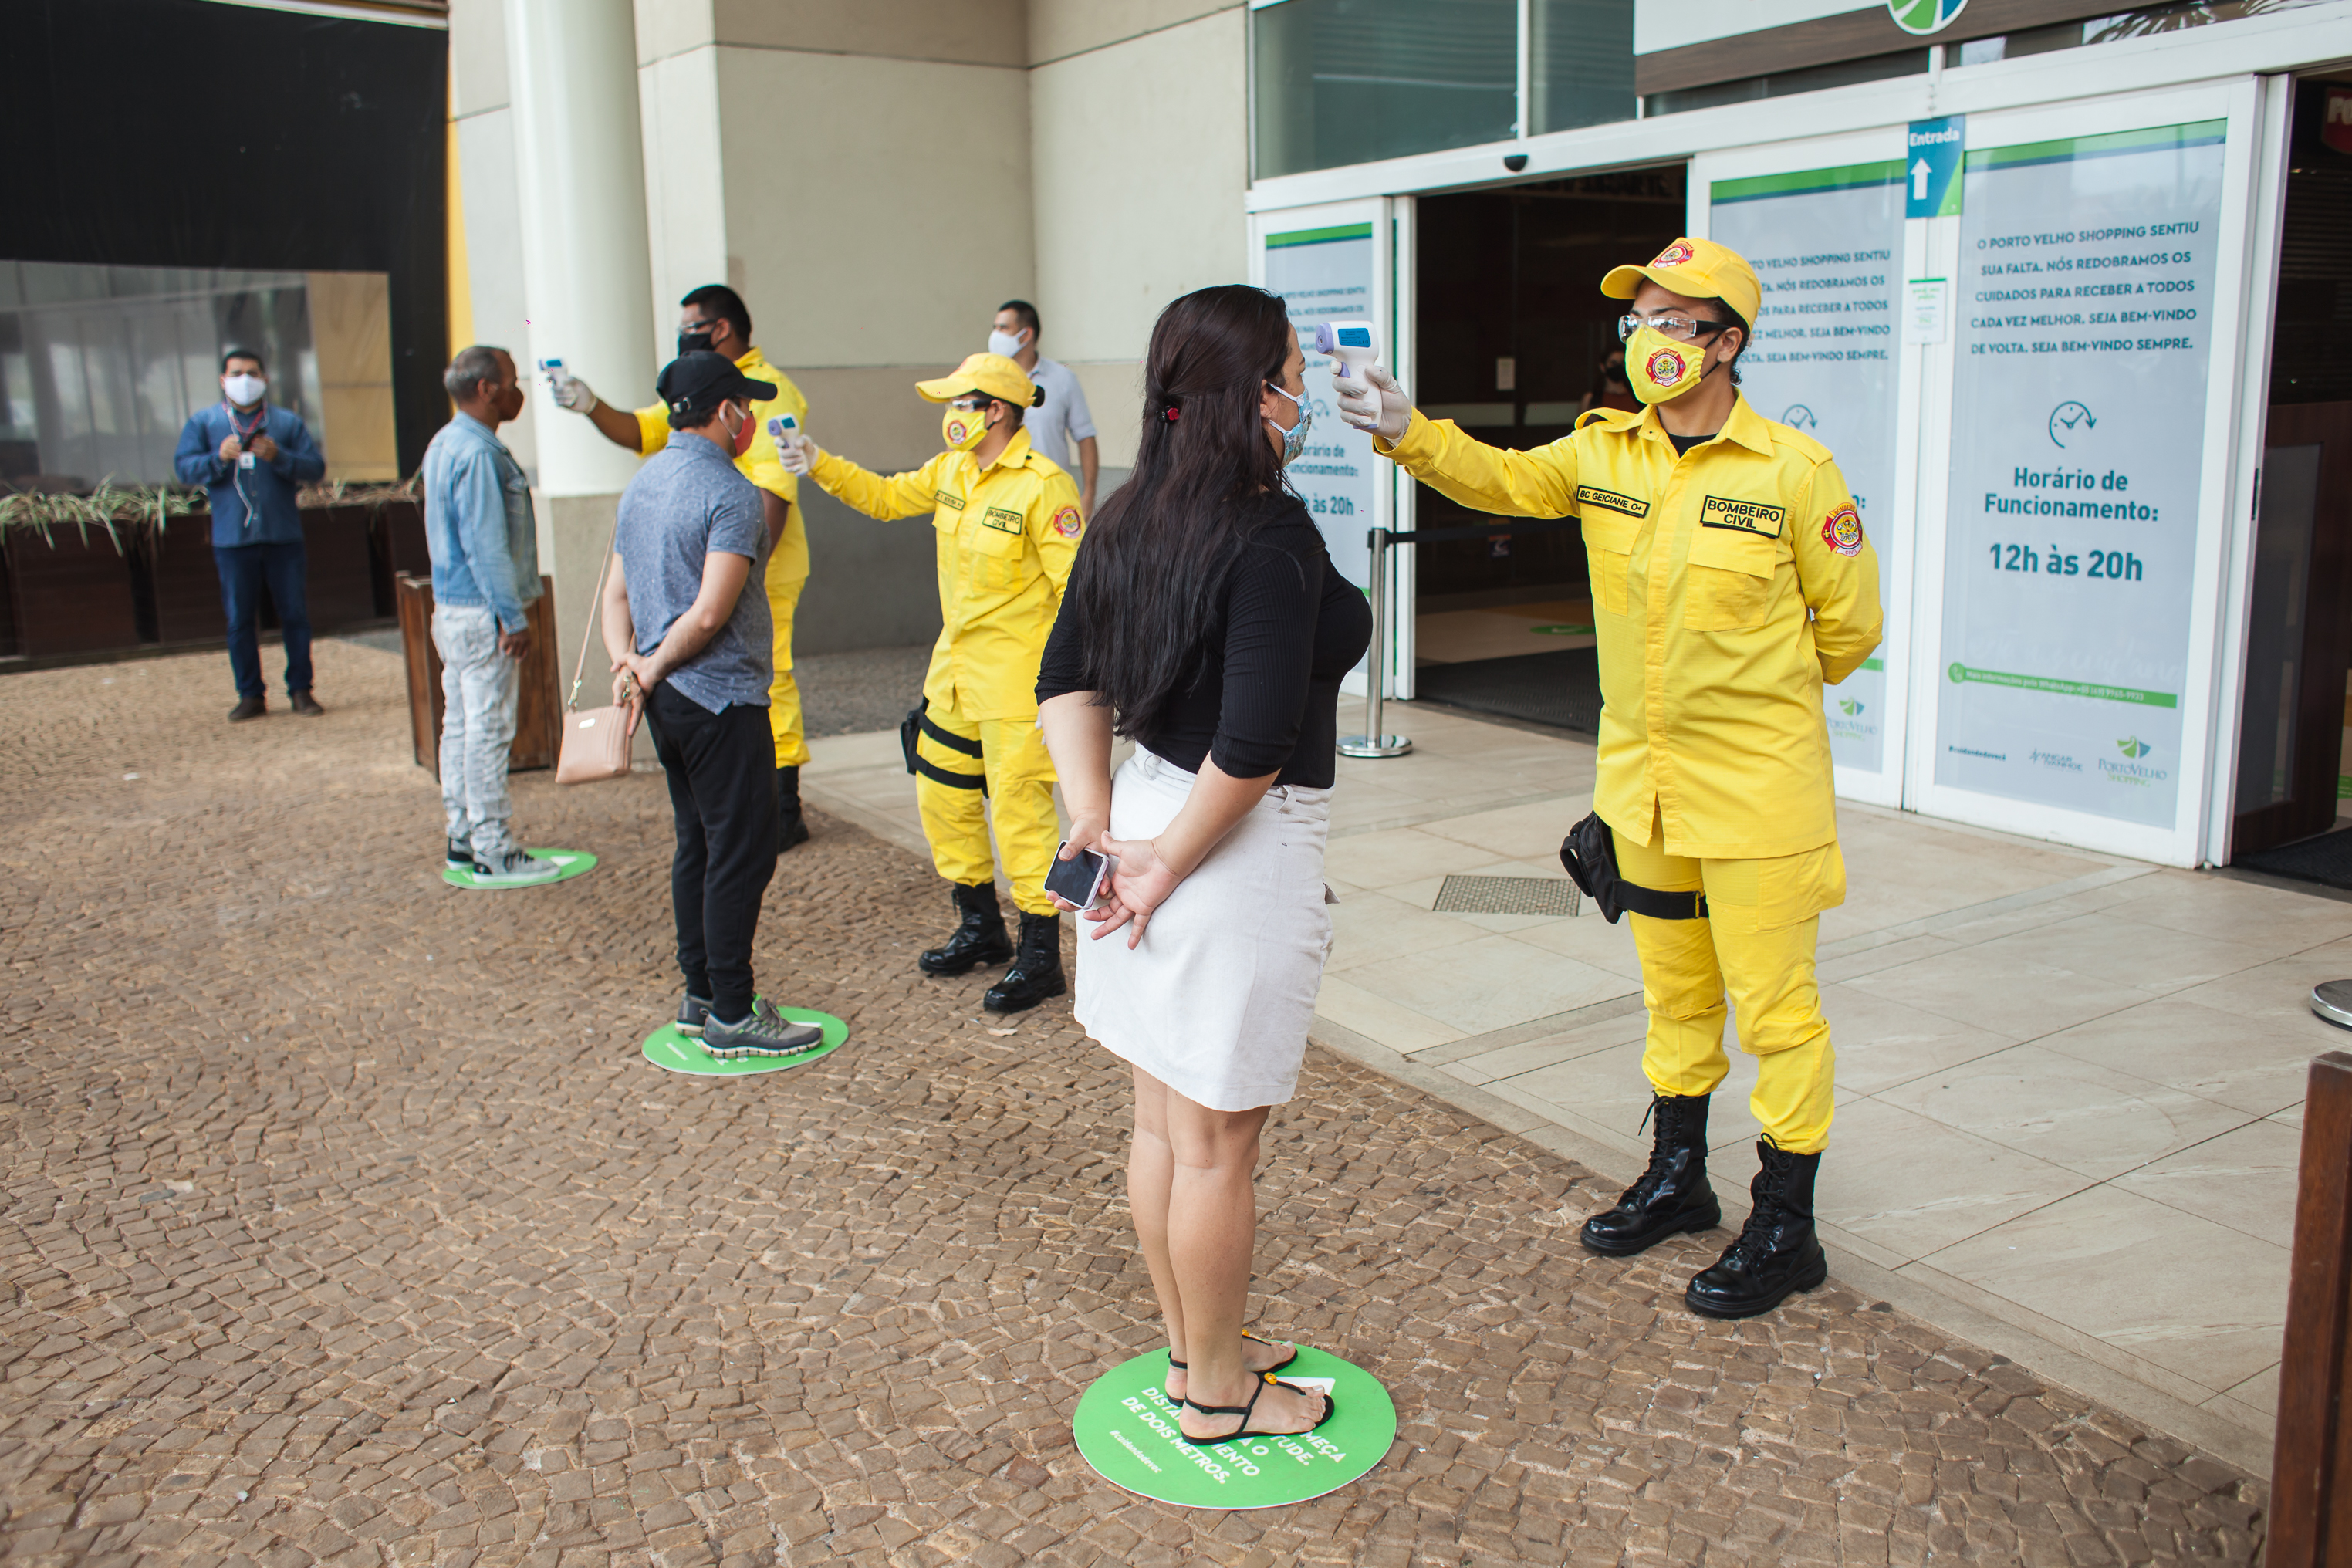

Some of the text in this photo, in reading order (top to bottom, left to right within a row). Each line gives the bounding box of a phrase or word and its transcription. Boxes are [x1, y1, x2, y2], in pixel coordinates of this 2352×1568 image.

[1909, 126, 1960, 147] Entrada
[1977, 221, 2199, 249] O PORTO VELHO SHOPPING SENTIU
[1766, 257, 1798, 269] VELHO
[1800, 252, 1851, 266] SHOPPING
[1854, 249, 1891, 262] SENTIU
[1981, 251, 2191, 276] SUA FALTA. NÓS REDOBRAMOS OS
[1799, 275, 1868, 289] REDOBRAMOS
[1870, 275, 1884, 286] OS
[1975, 280, 2195, 302] CUIDADOS PARA RECEBER A TODOS
[1772, 305, 1796, 315] PARA
[1799, 302, 1842, 313] RECEBER
[1853, 300, 1888, 311] TODOS
[1971, 309, 2197, 329] CADA VEZ MELHOR. SEJA BEM-VINDO
[1810, 327, 1831, 337] SEJA
[1833, 324, 1891, 336] BEM-VINDO
[1847, 350, 1888, 361] SEMPRE.
[1971, 337, 2193, 354] DE VOLTA. SEJA BEM-VINDO SEMPRE.
[1303, 441, 1345, 458] orário de
[1287, 461, 1359, 477] uncionamento:
[2014, 466, 2128, 491] Horário de
[1313, 493, 1326, 513] às
[1330, 496, 1353, 515] 20h
[1580, 489, 1590, 498] BC
[1592, 492, 1629, 508] GEICIANE
[1985, 493, 2158, 522] Funcionamento:
[988, 509, 1020, 525] BOMBEIRO
[1707, 499, 1779, 522] BOMBEIRO
[992, 519, 1008, 529] CIVIL
[1723, 513, 1756, 529] CIVIL
[1990, 542, 2143, 581] 12h às 20h
[1120, 1396, 1231, 1484] DE DOIS METROS.
[1299, 1431, 1347, 1463] MEÇA
[1251, 1445, 1269, 1456] O
